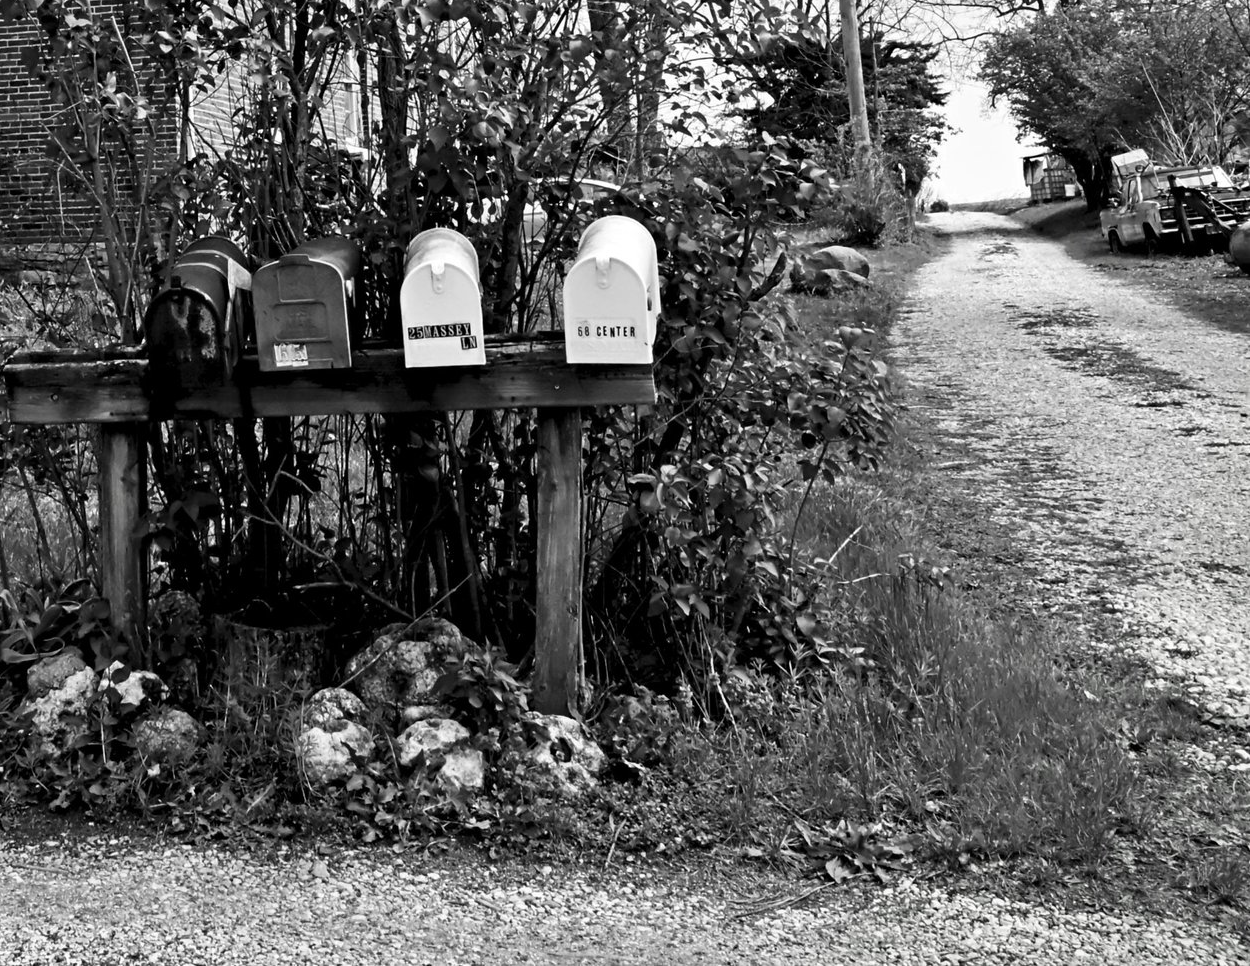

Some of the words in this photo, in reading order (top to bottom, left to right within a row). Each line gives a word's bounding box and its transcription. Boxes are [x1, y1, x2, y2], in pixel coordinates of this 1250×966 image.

[577, 325, 590, 337] 68
[596, 325, 636, 338] CENTER
[461, 336, 476, 349] LN
